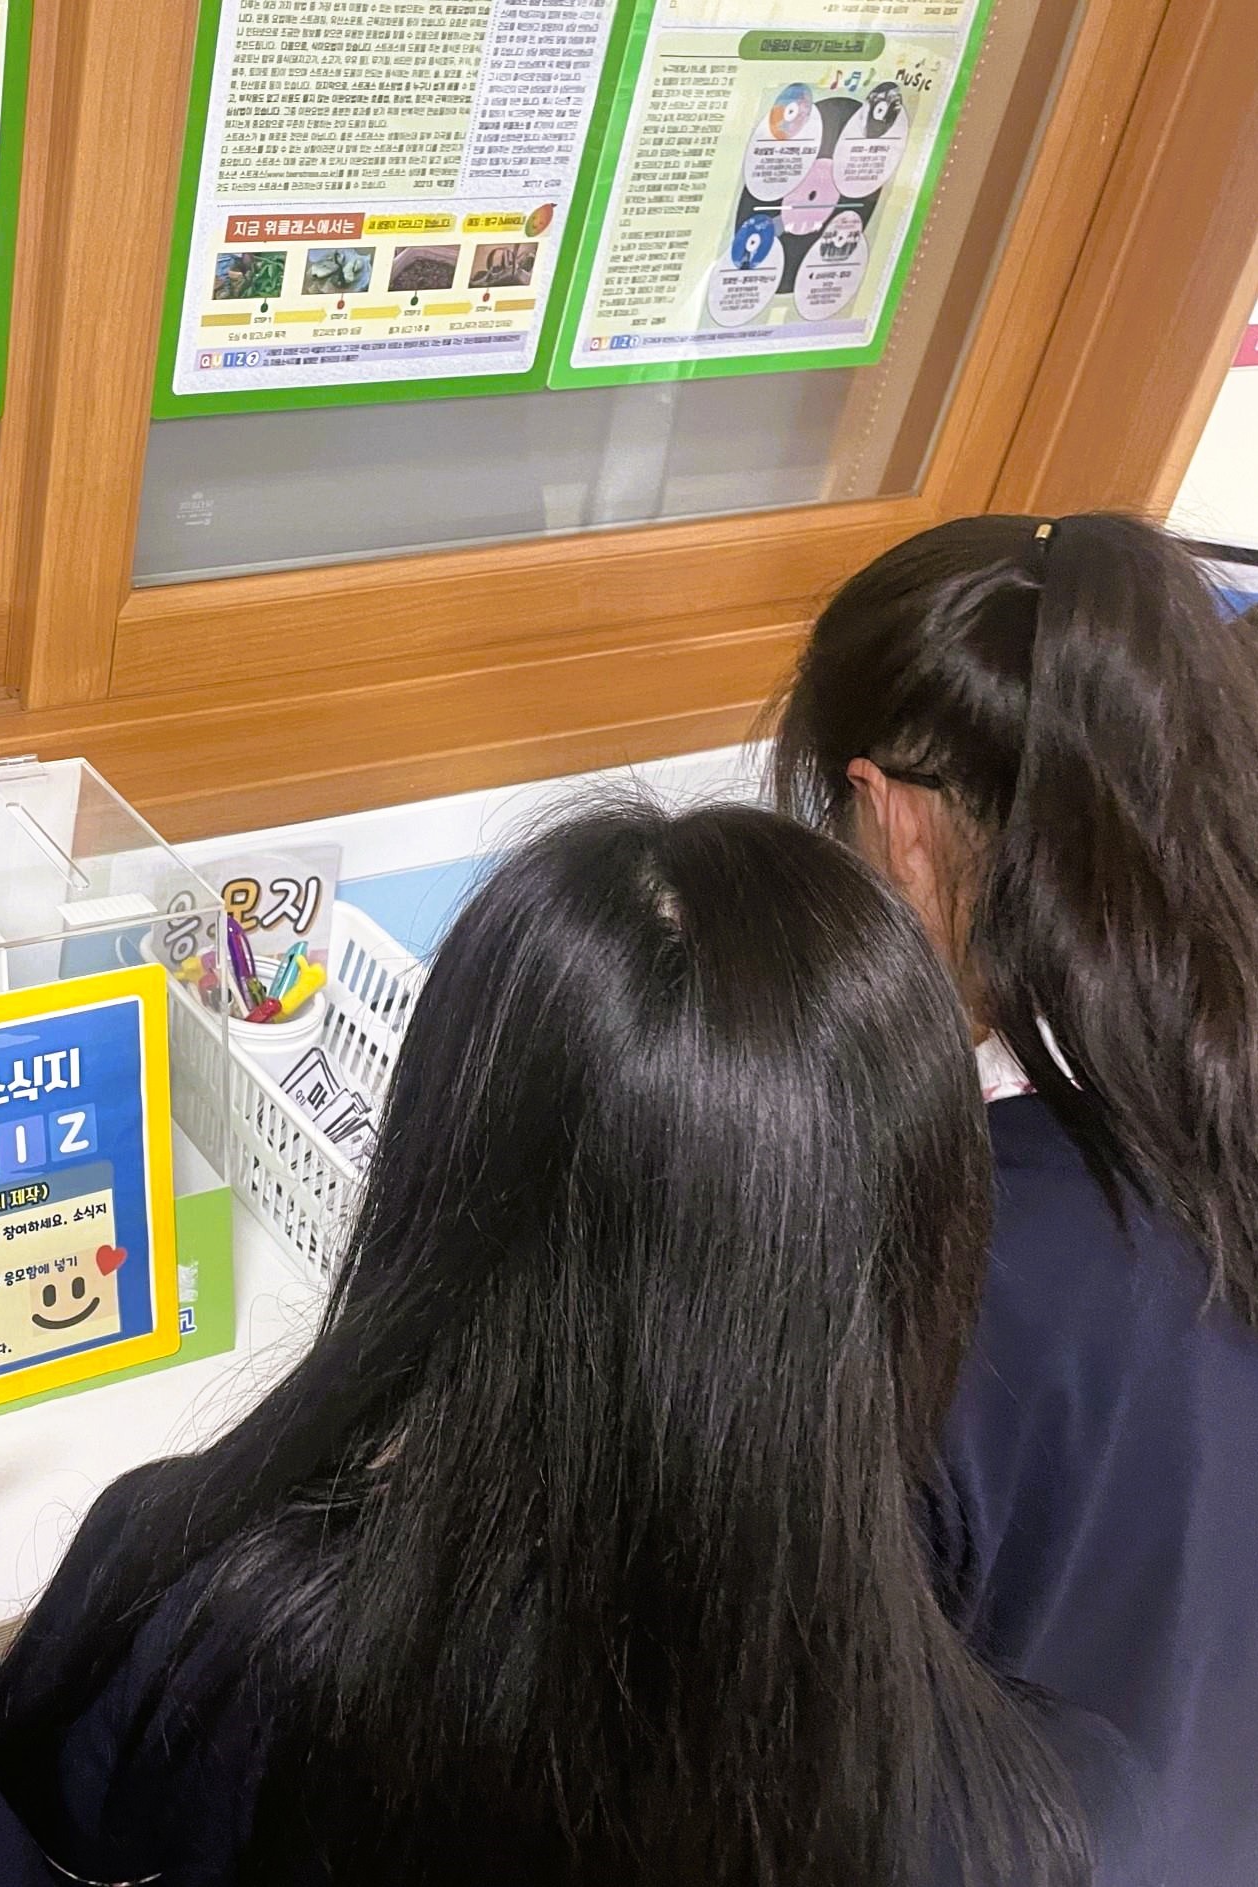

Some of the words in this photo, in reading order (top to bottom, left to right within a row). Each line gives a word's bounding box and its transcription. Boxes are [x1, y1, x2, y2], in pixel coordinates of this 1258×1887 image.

[896, 69, 932, 91] MUSIC
[234, 221, 260, 236] 지금
[265, 219, 355, 235] 위클래스에서는
[201, 352, 246, 368] QUIZ
[10, 1184, 50, 1208] 제작)
[3, 1215, 67, 1241] 참여하세요.
[73, 1203, 107, 1222] 소식지
[4, 1263, 49, 1287] 응모함에
[54, 1256, 78, 1272] 넣기
